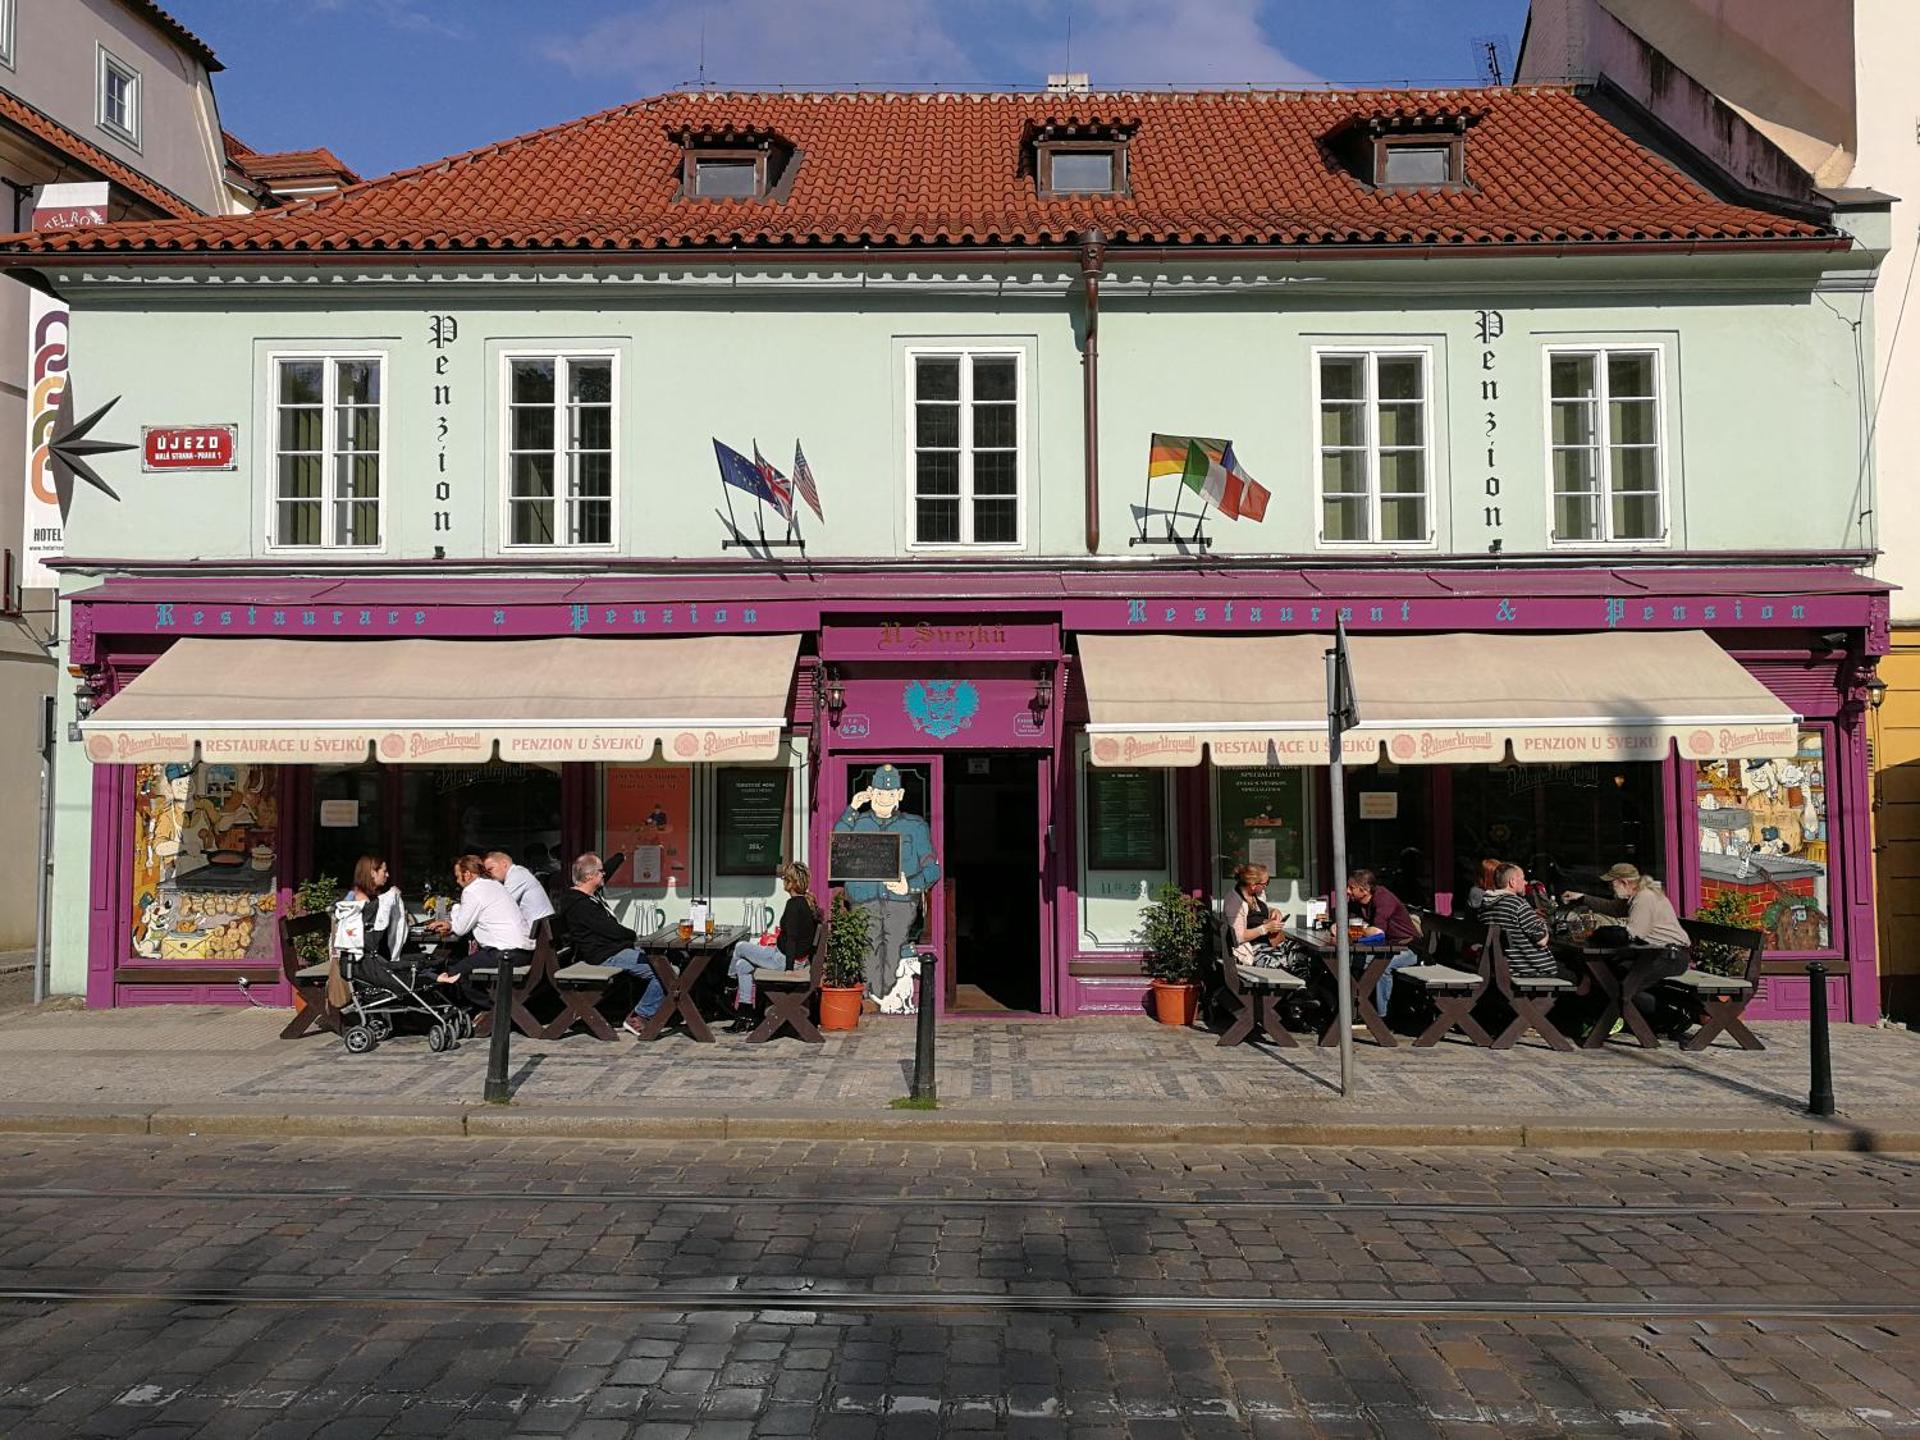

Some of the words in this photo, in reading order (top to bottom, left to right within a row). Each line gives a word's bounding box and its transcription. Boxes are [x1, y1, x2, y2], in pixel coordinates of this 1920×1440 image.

[428, 315, 457, 531] Penzion
[1474, 310, 1503, 527] Penzion
[33, 528, 63, 541] HOTEL
[155, 603, 426, 630] Restaurace
[494, 609, 506, 625] a
[569, 602, 757, 632] Penzion
[1127, 599, 1410, 625] Restaurant
[1495, 598, 1517, 622] &
[1604, 598, 1806, 629] Pension
[206, 738, 295, 752] RESTAURACE
[300, 739, 310, 751] U
[314, 735, 365, 751] ŠVEJKŮ
[512, 738, 573, 750] PENZION
[578, 738, 587, 750] U
[592, 735, 644, 750] ŠVEJKŮ
[1309, 740, 1318, 752] U
[1525, 737, 1586, 750] PENZION
[1592, 736, 1601, 750] U
